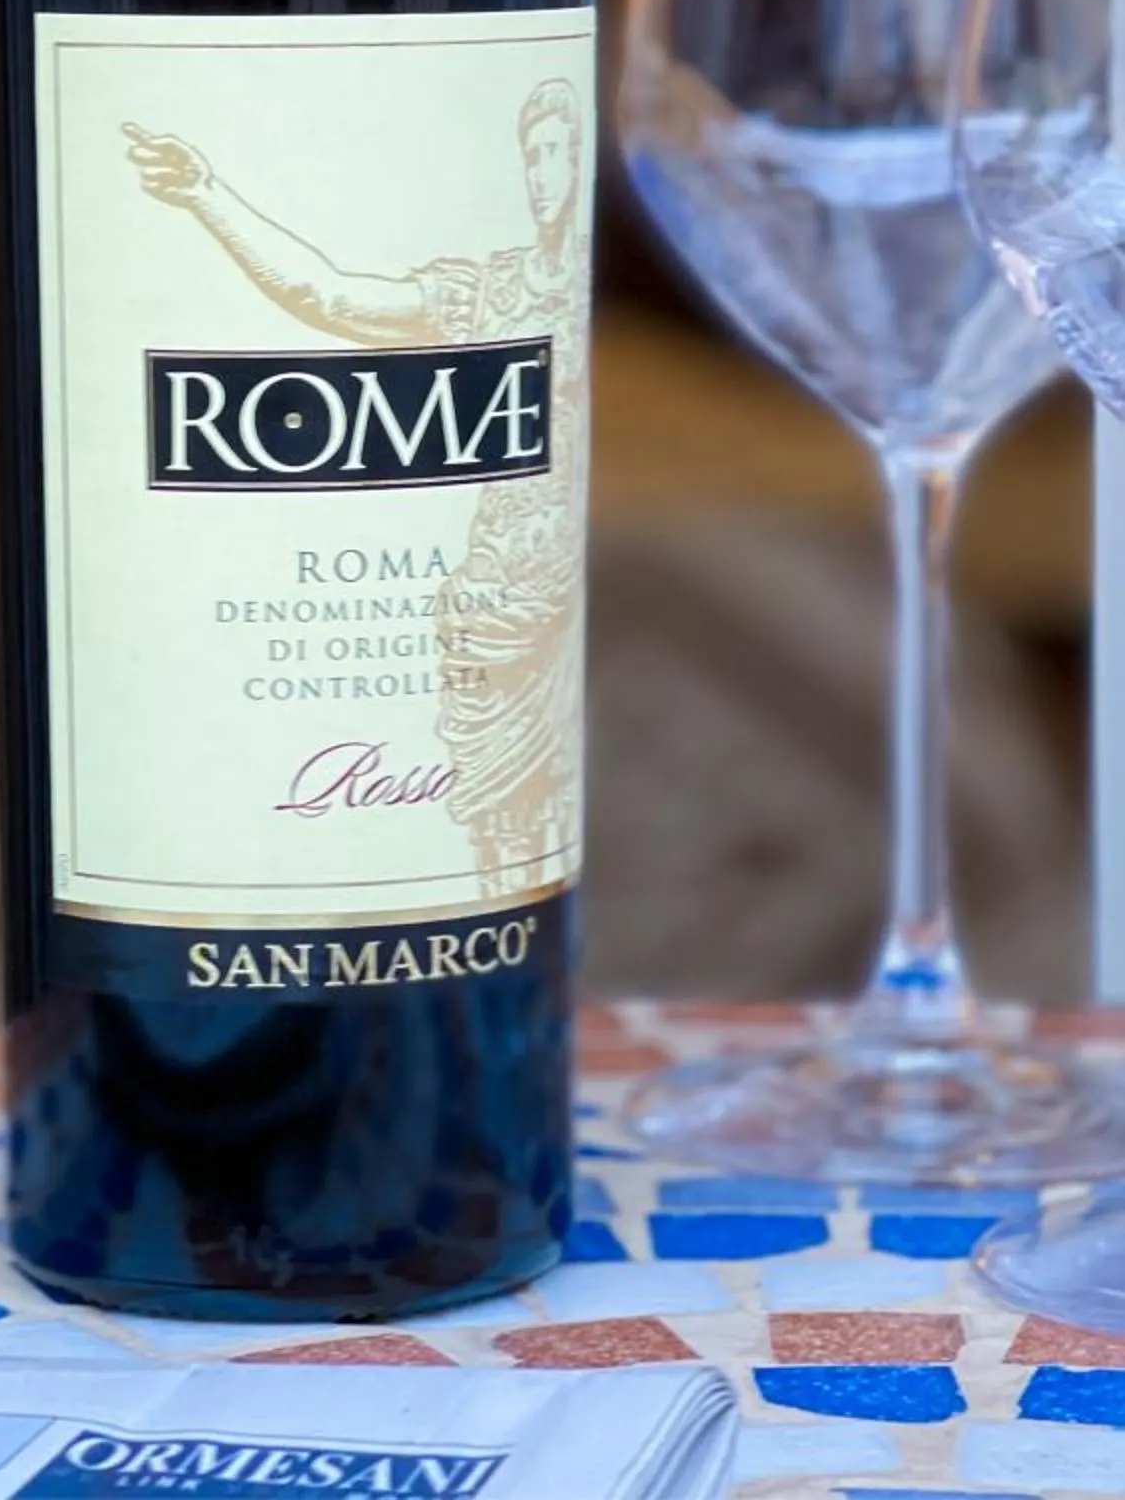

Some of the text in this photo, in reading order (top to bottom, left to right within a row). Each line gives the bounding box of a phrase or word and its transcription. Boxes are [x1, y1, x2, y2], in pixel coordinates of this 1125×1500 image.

[297, 546, 452, 583] ROMA
[215, 591, 509, 623] DENOMINAZIONE
[267, 628, 472, 662] DI ORIGINE
[242, 668, 490, 701] CONTROLLATA
[272, 741, 458, 819] Rosso
[187, 942, 315, 988] SAN
[65, 1437, 497, 1495] ORMESANI
